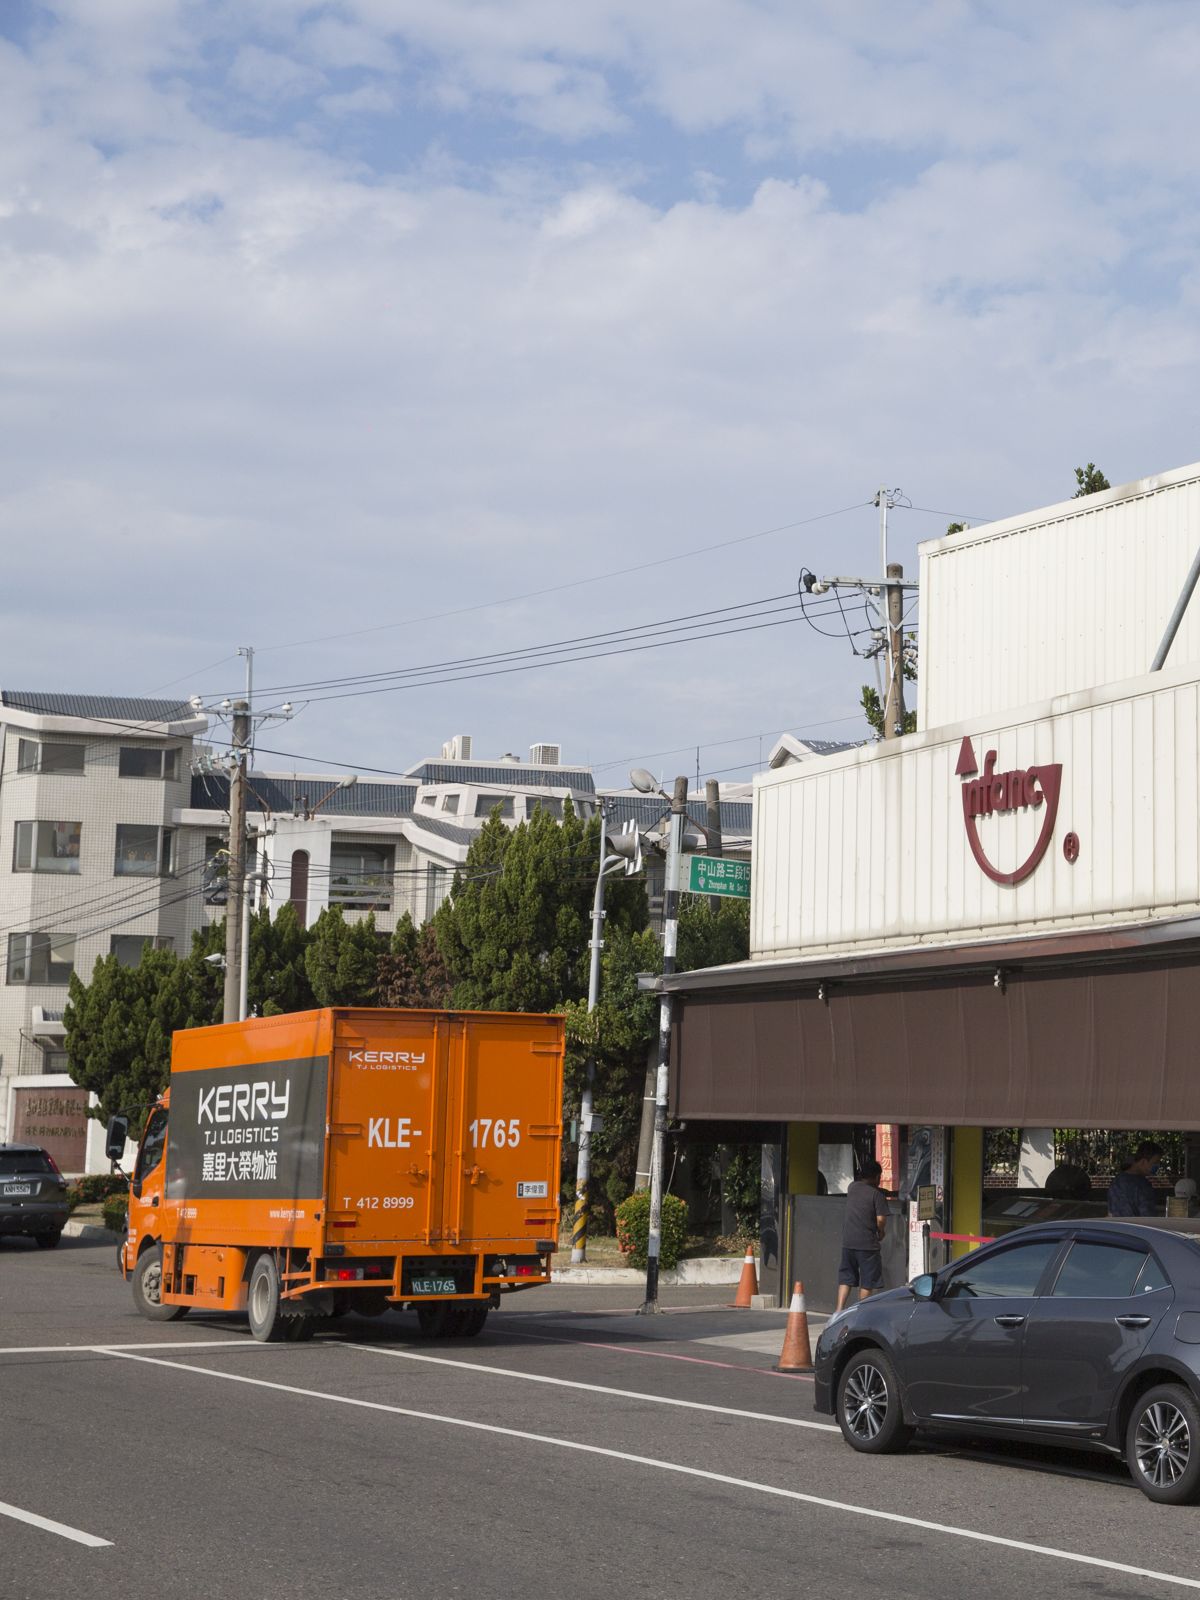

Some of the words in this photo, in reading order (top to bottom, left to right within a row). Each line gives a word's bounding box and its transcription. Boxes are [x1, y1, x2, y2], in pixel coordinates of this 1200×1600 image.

[349, 1051, 425, 1064] KERRY
[198, 1079, 290, 1125] KERRY
[204, 1130, 217, 1146] TJ
[220, 1126, 279, 1145] LOGISTICS
[368, 1118, 422, 1148] KLE-
[469, 1119, 520, 1148] 1765
[202, 1149, 278, 1182] 嘉里大榮物流
[343, 1198, 351, 1209] T
[356, 1198, 379, 1209] 412
[383, 1198, 414, 1209] 8999
